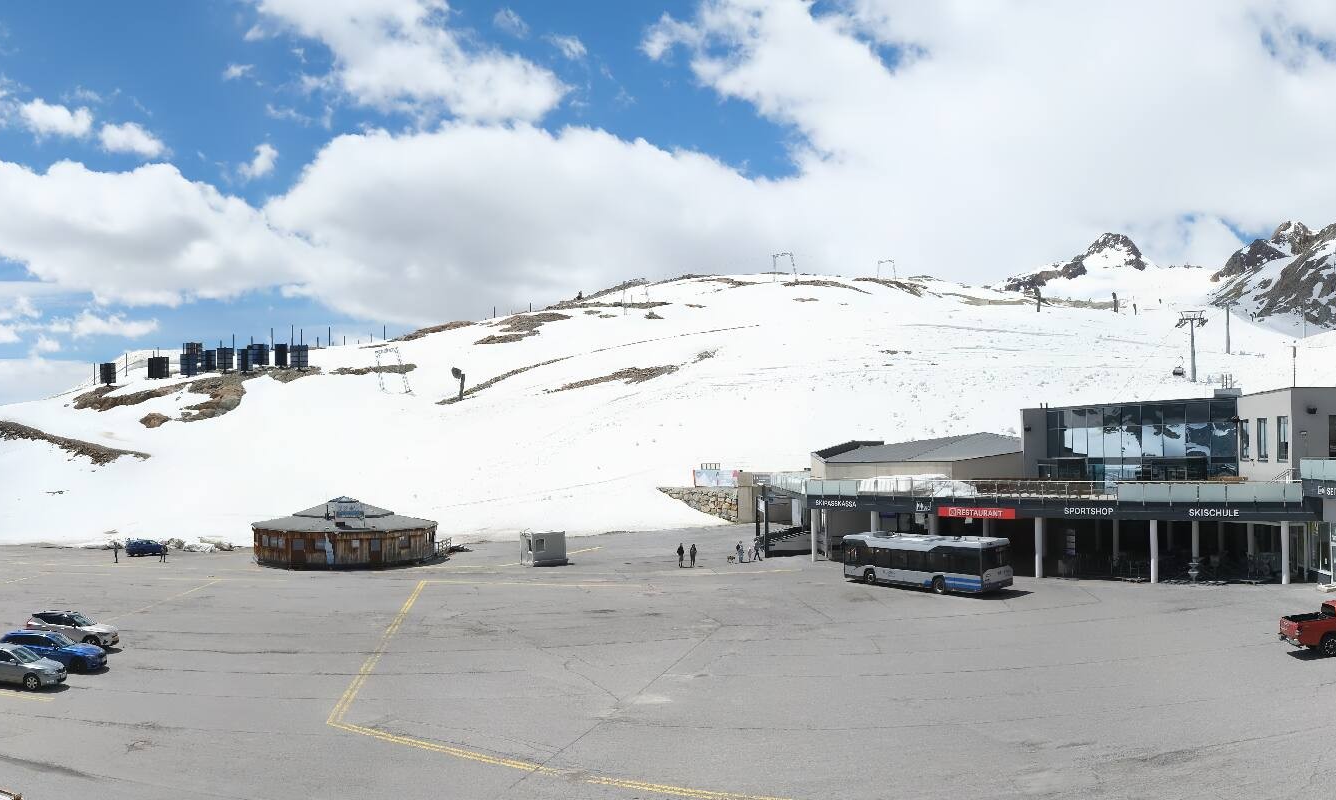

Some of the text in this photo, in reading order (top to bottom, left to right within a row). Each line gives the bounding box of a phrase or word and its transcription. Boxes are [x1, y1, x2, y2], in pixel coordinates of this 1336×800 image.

[956, 508, 1004, 517] RESTAURANT
[1064, 507, 1114, 516] SPORTSHOP
[1188, 508, 1240, 518] SKISCHULE
